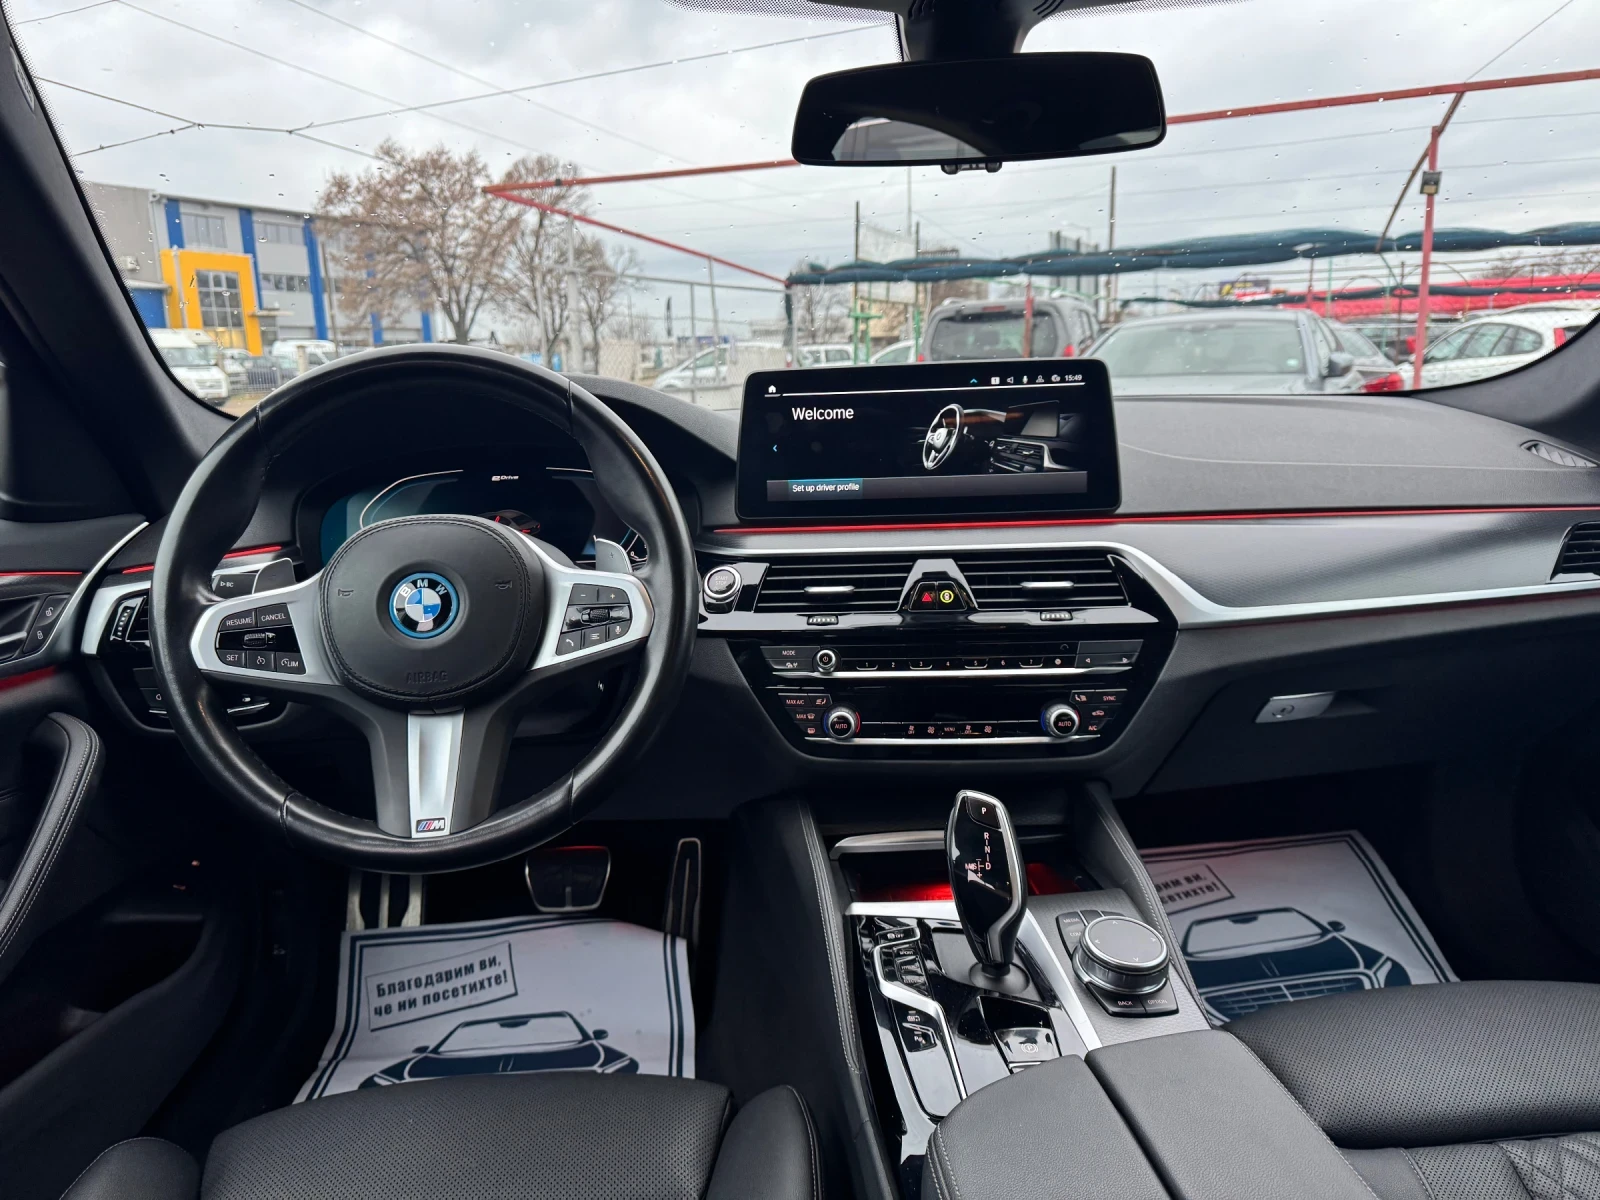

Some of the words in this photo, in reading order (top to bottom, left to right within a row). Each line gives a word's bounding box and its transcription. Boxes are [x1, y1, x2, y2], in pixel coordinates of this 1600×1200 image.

[791, 406, 854, 420] Welcome
[792, 484, 804, 492] Set
[816, 483, 836, 491] driver
[837, 483, 860, 492] profile
[400, 579, 447, 597] BMW
[226, 617, 253, 626] RESUME
[261, 613, 286, 622] CANCEL
[287, 659, 299, 667] LIM
[406, 670, 448, 684] AIRBAG
[981, 807, 987, 815] P
[984, 832, 990, 840] R
[985, 846, 991, 854] N
[985, 862, 992, 870] D
[376, 962, 475, 998] Благодарим
[479, 955, 501, 972] ви,
[374, 1003, 393, 1017] че
[397, 997, 418, 1013] ни
[422, 969, 509, 1006] посетихте!
